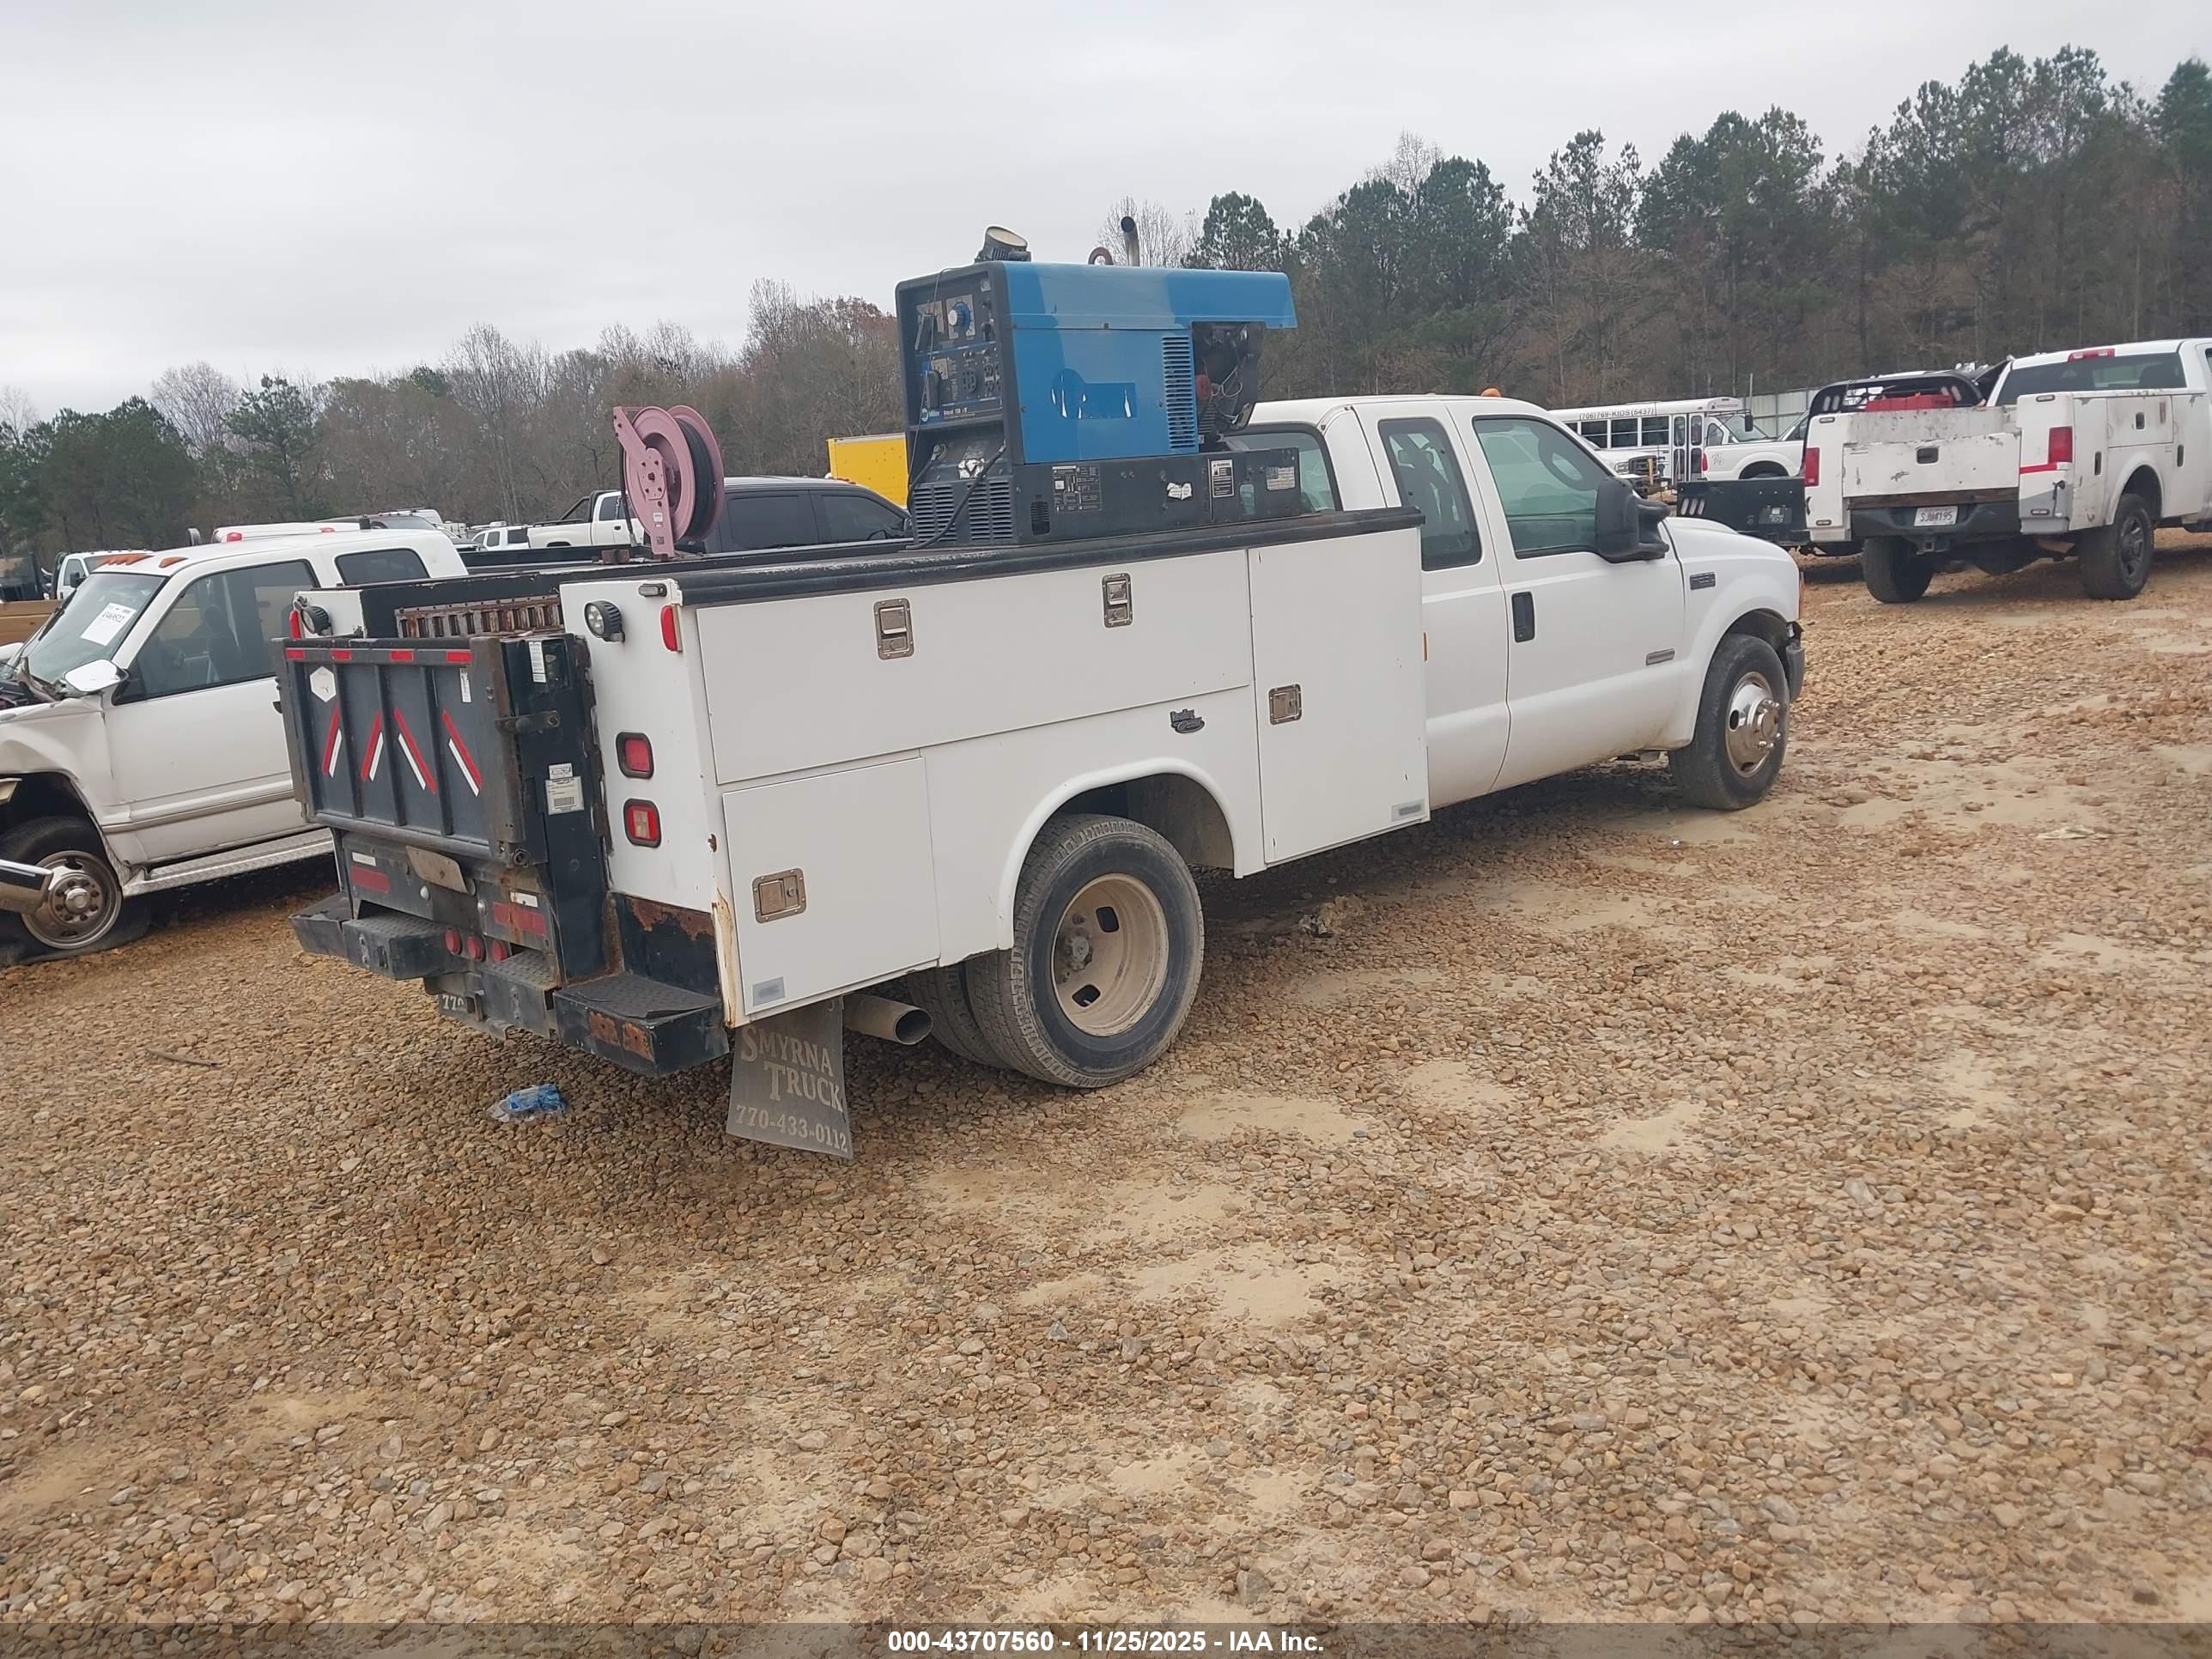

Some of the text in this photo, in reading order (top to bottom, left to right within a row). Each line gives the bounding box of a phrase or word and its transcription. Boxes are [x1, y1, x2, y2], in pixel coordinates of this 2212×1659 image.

[740, 1025, 834, 1077] SMYRNA
[764, 1060, 843, 1113] TRUCK
[736, 1104, 848, 1152] 770-433-0112
